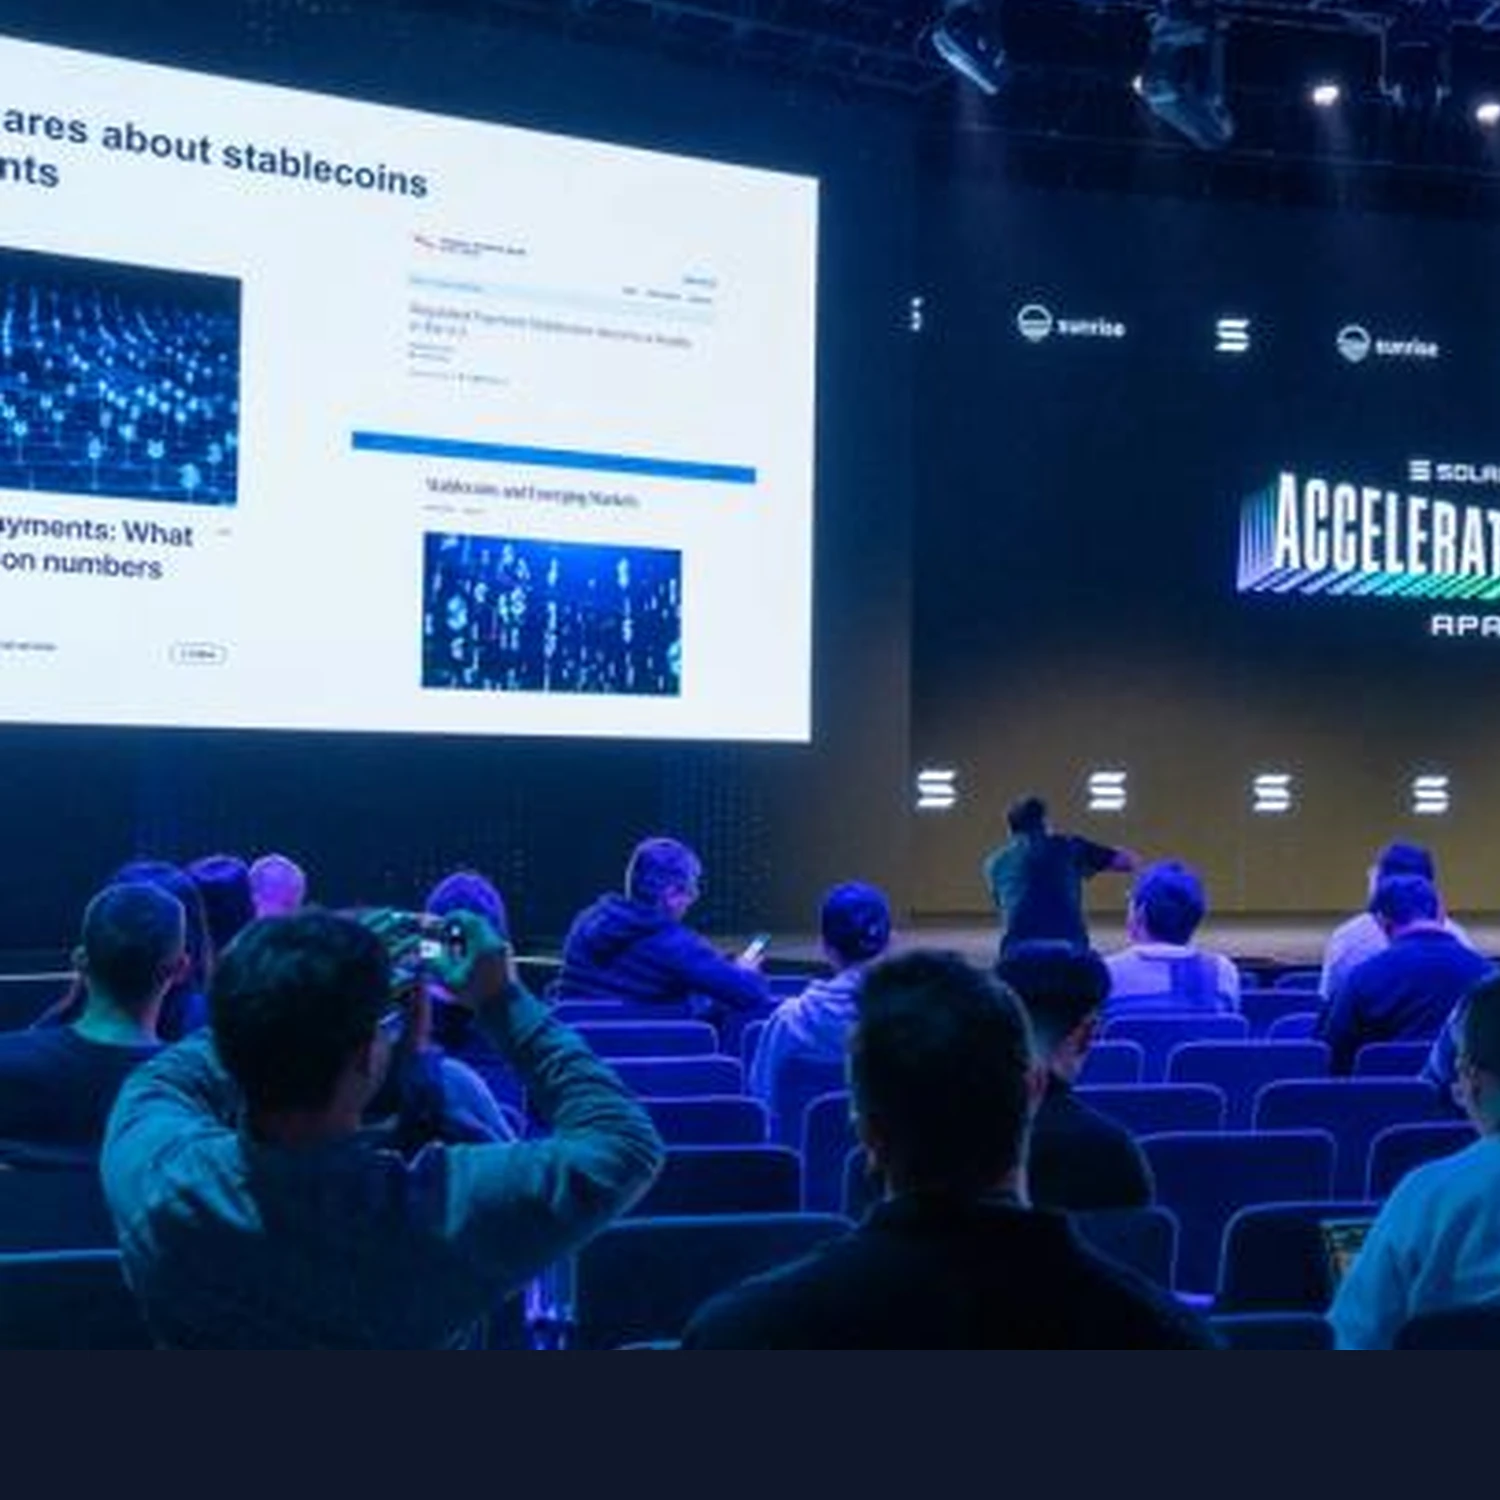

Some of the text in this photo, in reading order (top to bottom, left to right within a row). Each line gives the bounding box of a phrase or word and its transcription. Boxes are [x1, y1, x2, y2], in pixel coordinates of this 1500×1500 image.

[101, 122, 211, 164] about
[222, 144, 429, 198] stablecoins
[1057, 317, 1126, 338] sunrise
[1376, 335, 1439, 358] sunrise
[122, 520, 193, 546] What
[43, 554, 163, 579] numbers
